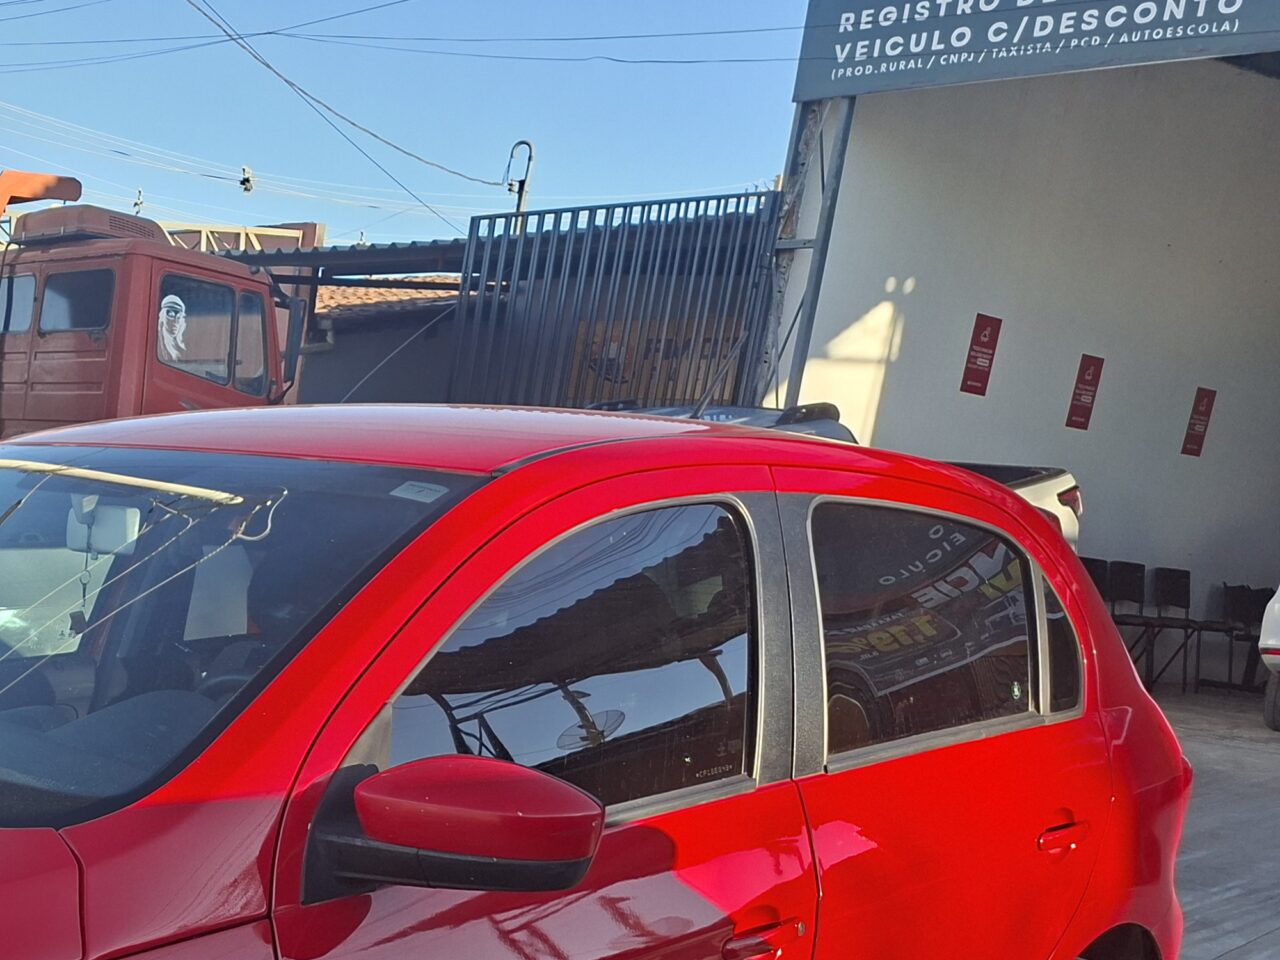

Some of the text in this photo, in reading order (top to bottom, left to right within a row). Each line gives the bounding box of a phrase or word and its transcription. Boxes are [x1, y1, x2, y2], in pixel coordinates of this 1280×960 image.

[834, 0, 1244, 63] VEICULO C/DESCONTO
[838, 0, 1001, 33] REGISTRO
[939, 53, 975, 66] CNPJ
[992, 42, 1052, 59] TAXISTA
[1070, 35, 1101, 50] PCD
[1119, 18, 1239, 44] AUTOESCOLA)
